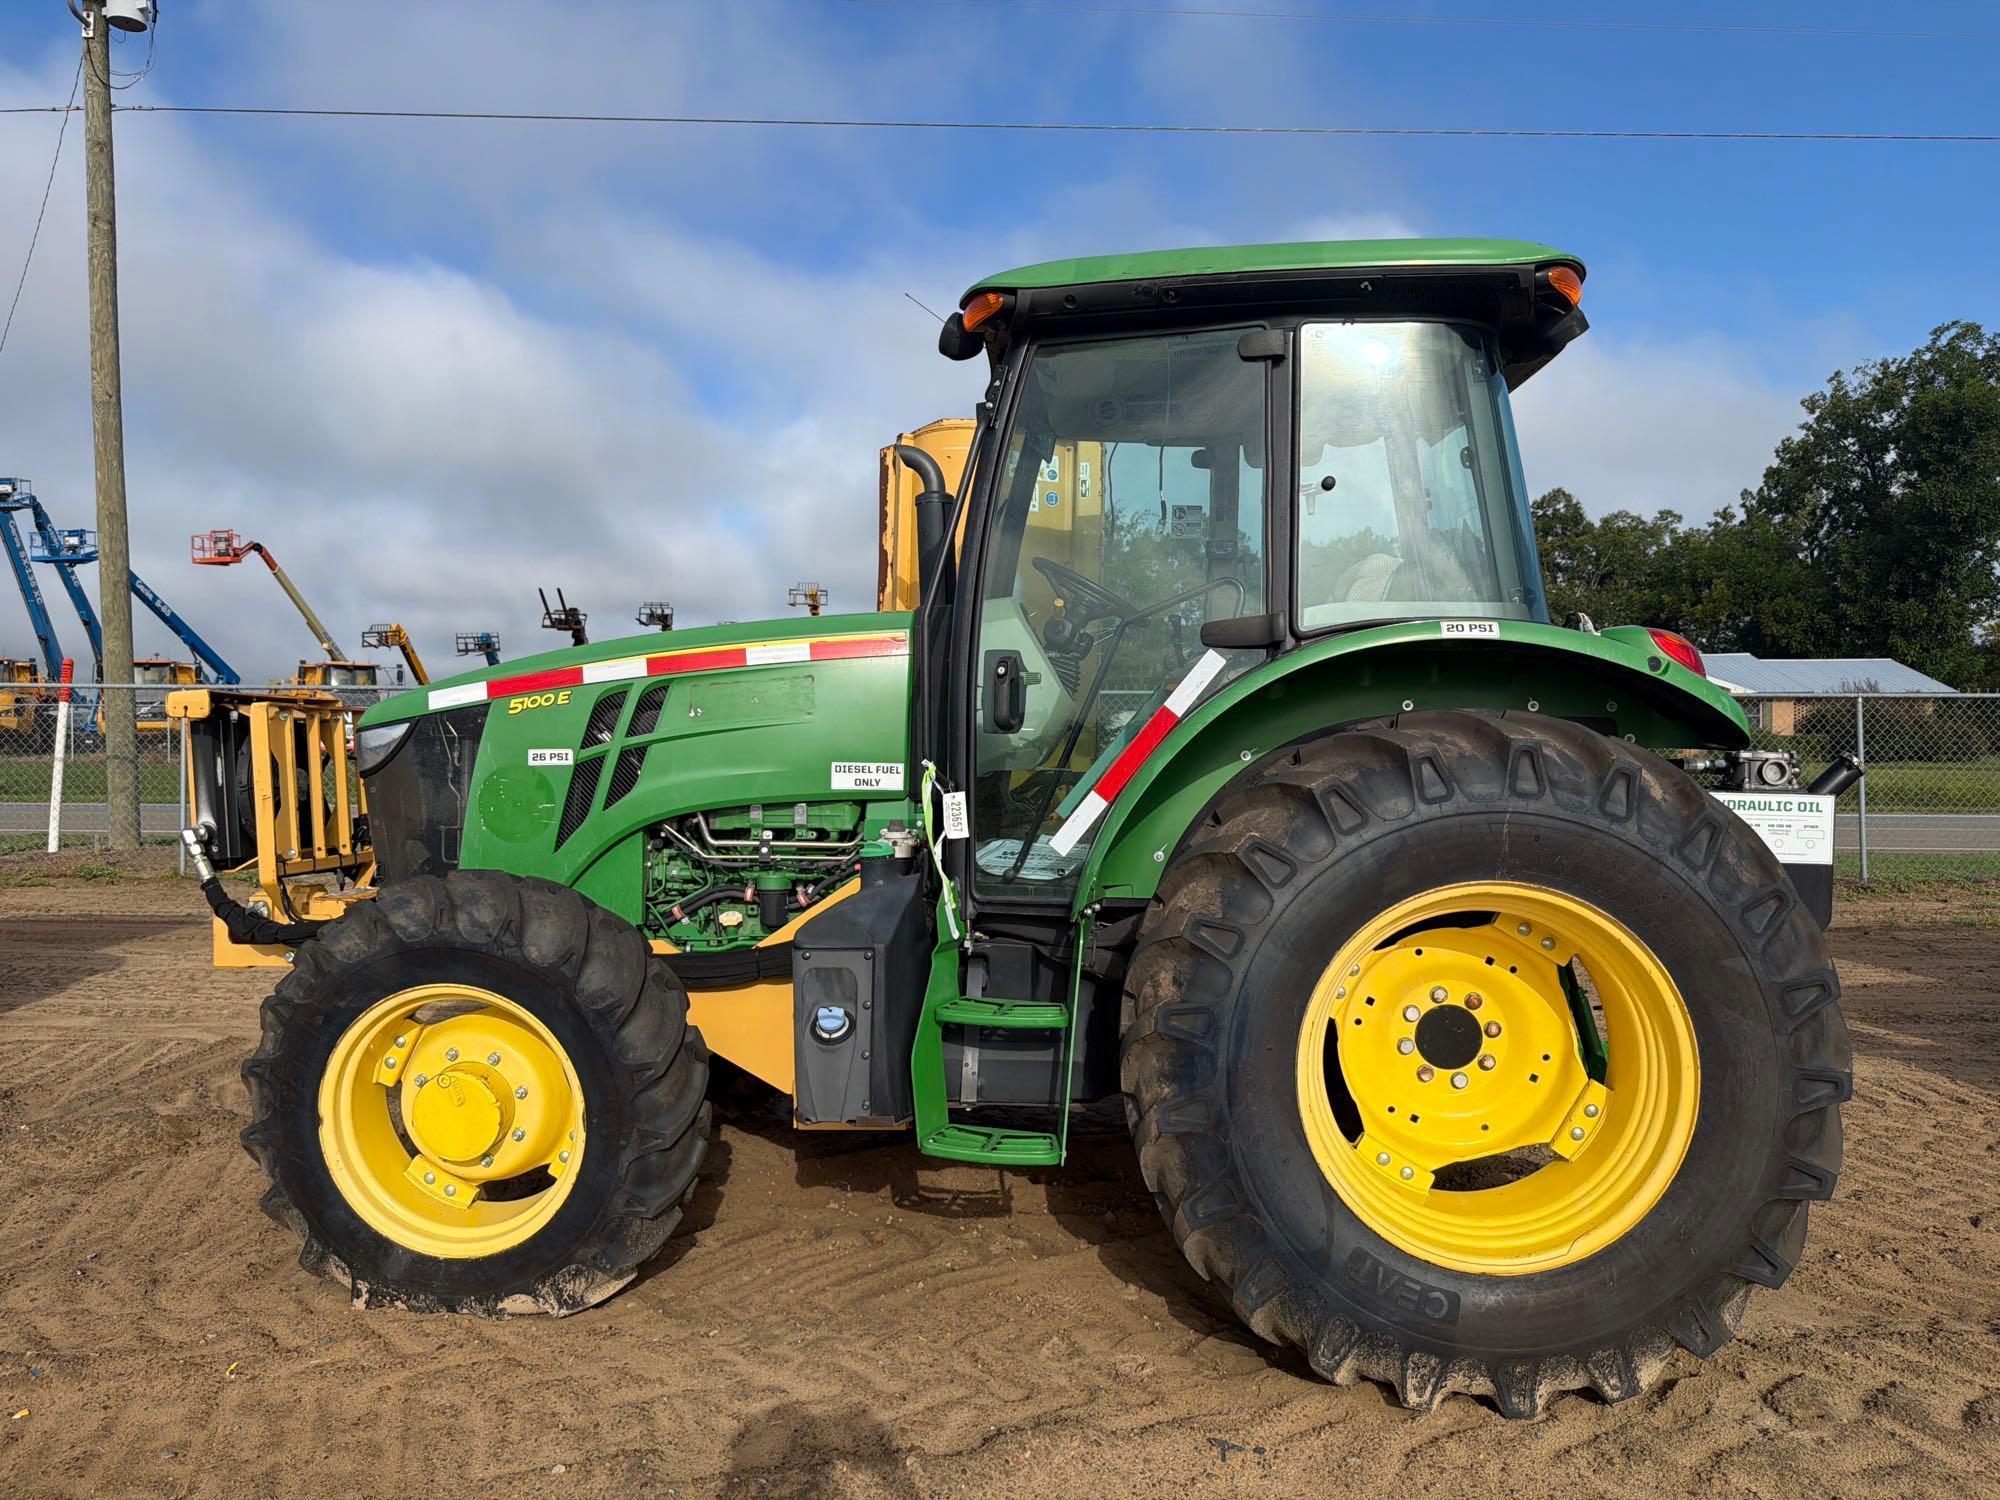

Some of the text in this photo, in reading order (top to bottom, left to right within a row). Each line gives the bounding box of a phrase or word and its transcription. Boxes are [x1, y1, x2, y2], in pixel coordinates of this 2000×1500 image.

[1446, 624, 1494, 633] 20 PSI
[508, 690, 572, 715] 5100 E
[531, 752, 570, 761] 26 PSI
[834, 764, 901, 775] DIESEL FUEL
[854, 778, 881, 787] ONLY
[1721, 799, 1823, 813] DRAULIC OIL
[950, 801, 963, 833] 223657
